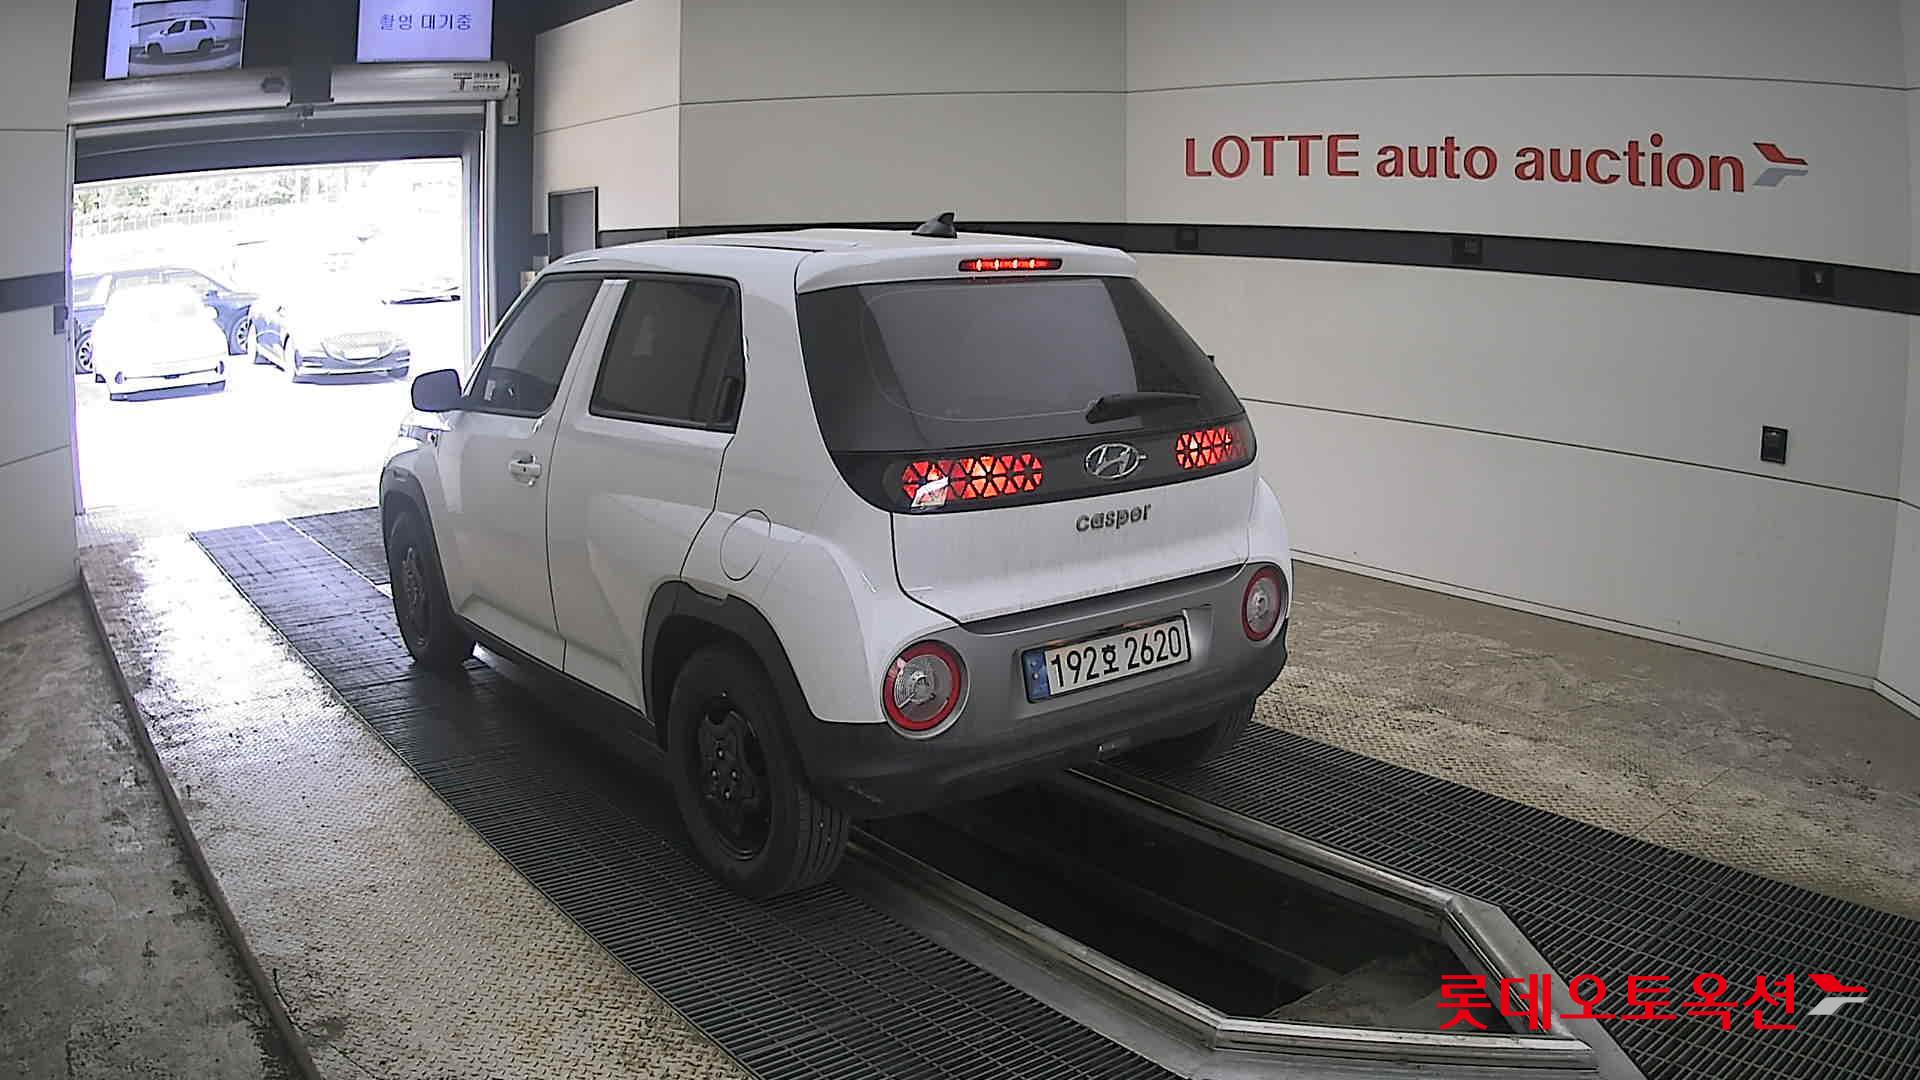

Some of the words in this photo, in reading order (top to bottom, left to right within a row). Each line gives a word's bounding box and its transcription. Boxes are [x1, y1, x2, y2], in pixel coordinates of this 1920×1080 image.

[421, 13, 472, 30] 대기중
[1185, 134, 1360, 178] LOTTE
[1376, 136, 1498, 180] auto
[1514, 132, 1746, 193] auction
[1076, 504, 1152, 532] casper
[1050, 644, 1119, 688] 192호
[1124, 626, 1183, 671] 2620
